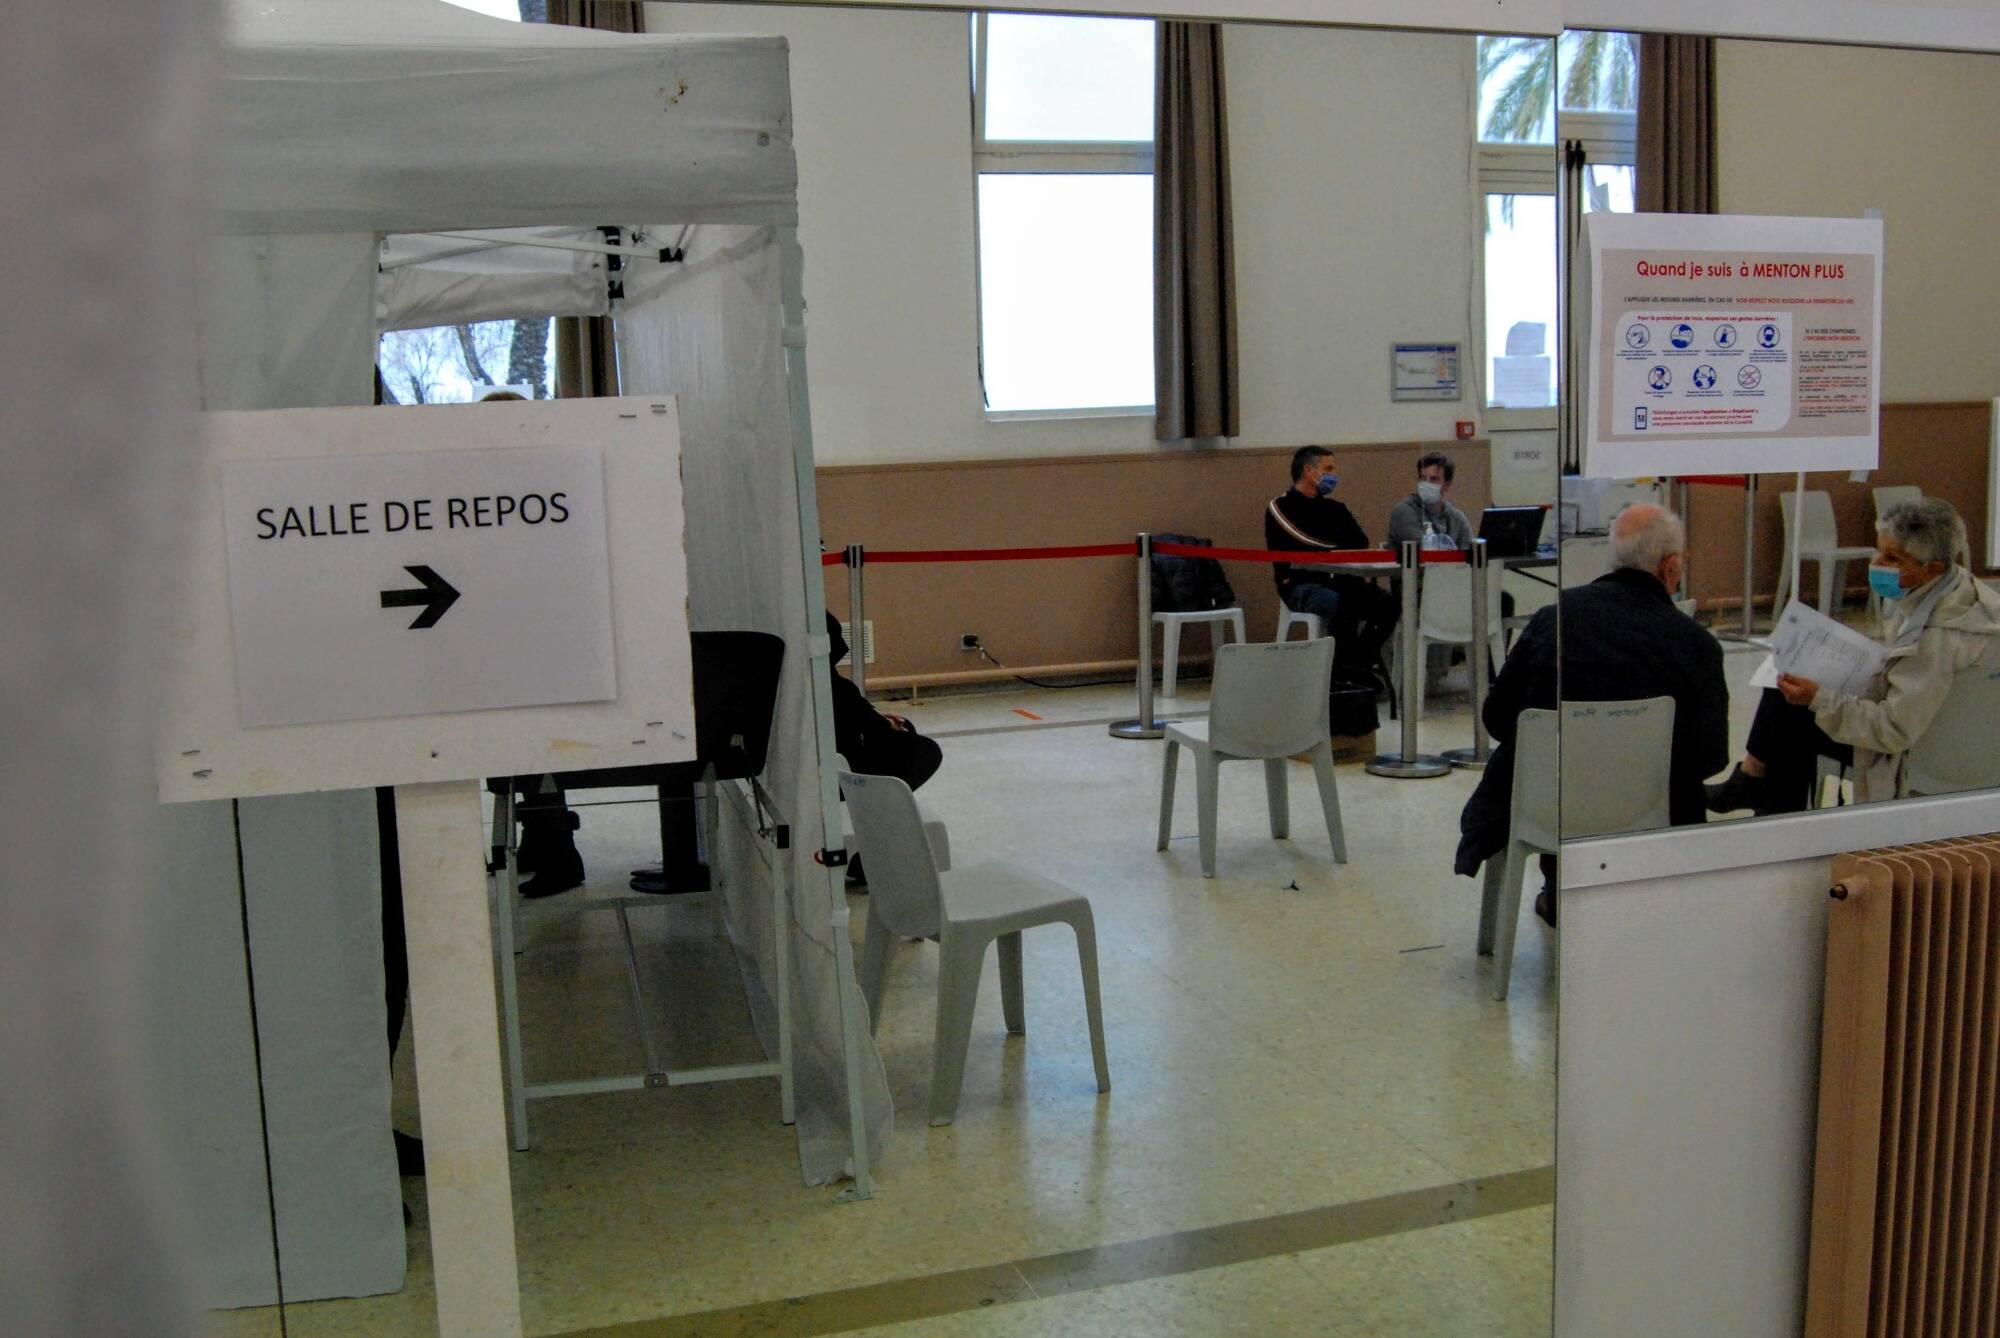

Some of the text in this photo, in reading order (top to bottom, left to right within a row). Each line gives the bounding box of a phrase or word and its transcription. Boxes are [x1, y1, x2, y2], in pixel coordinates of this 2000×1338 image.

[1637, 261, 1844, 279] Quand je suis à MENTON PLUS
[256, 492, 569, 540] SALLE DE REPOS
